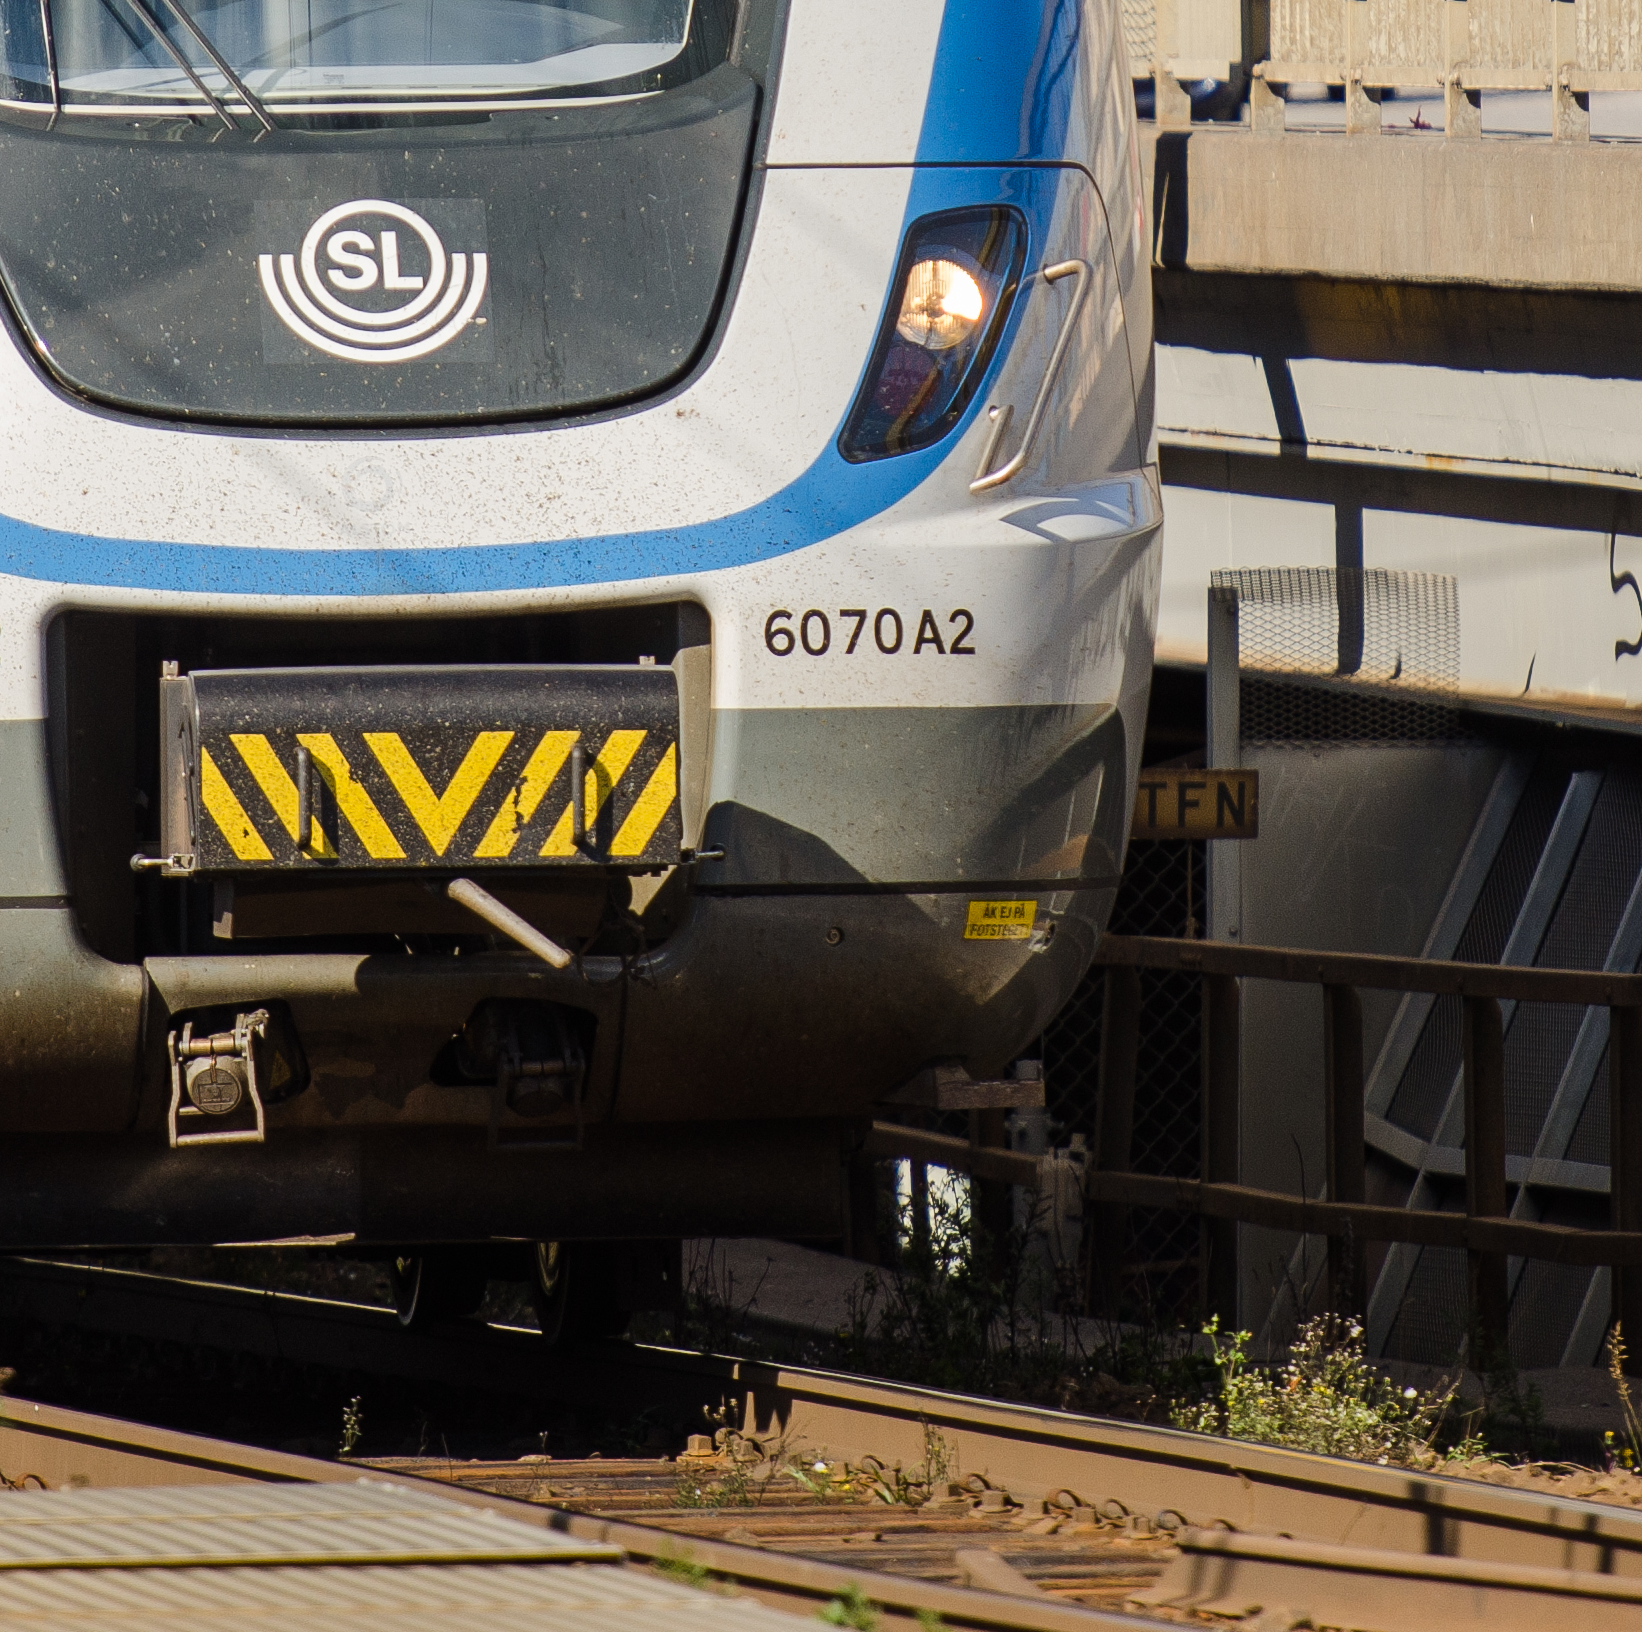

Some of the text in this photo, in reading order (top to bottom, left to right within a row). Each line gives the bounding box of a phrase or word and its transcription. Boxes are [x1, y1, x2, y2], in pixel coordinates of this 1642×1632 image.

[327, 230, 424, 290] SL
[764, 607, 976, 657] 6070 A2
[1137, 780, 1246, 828] TFN
